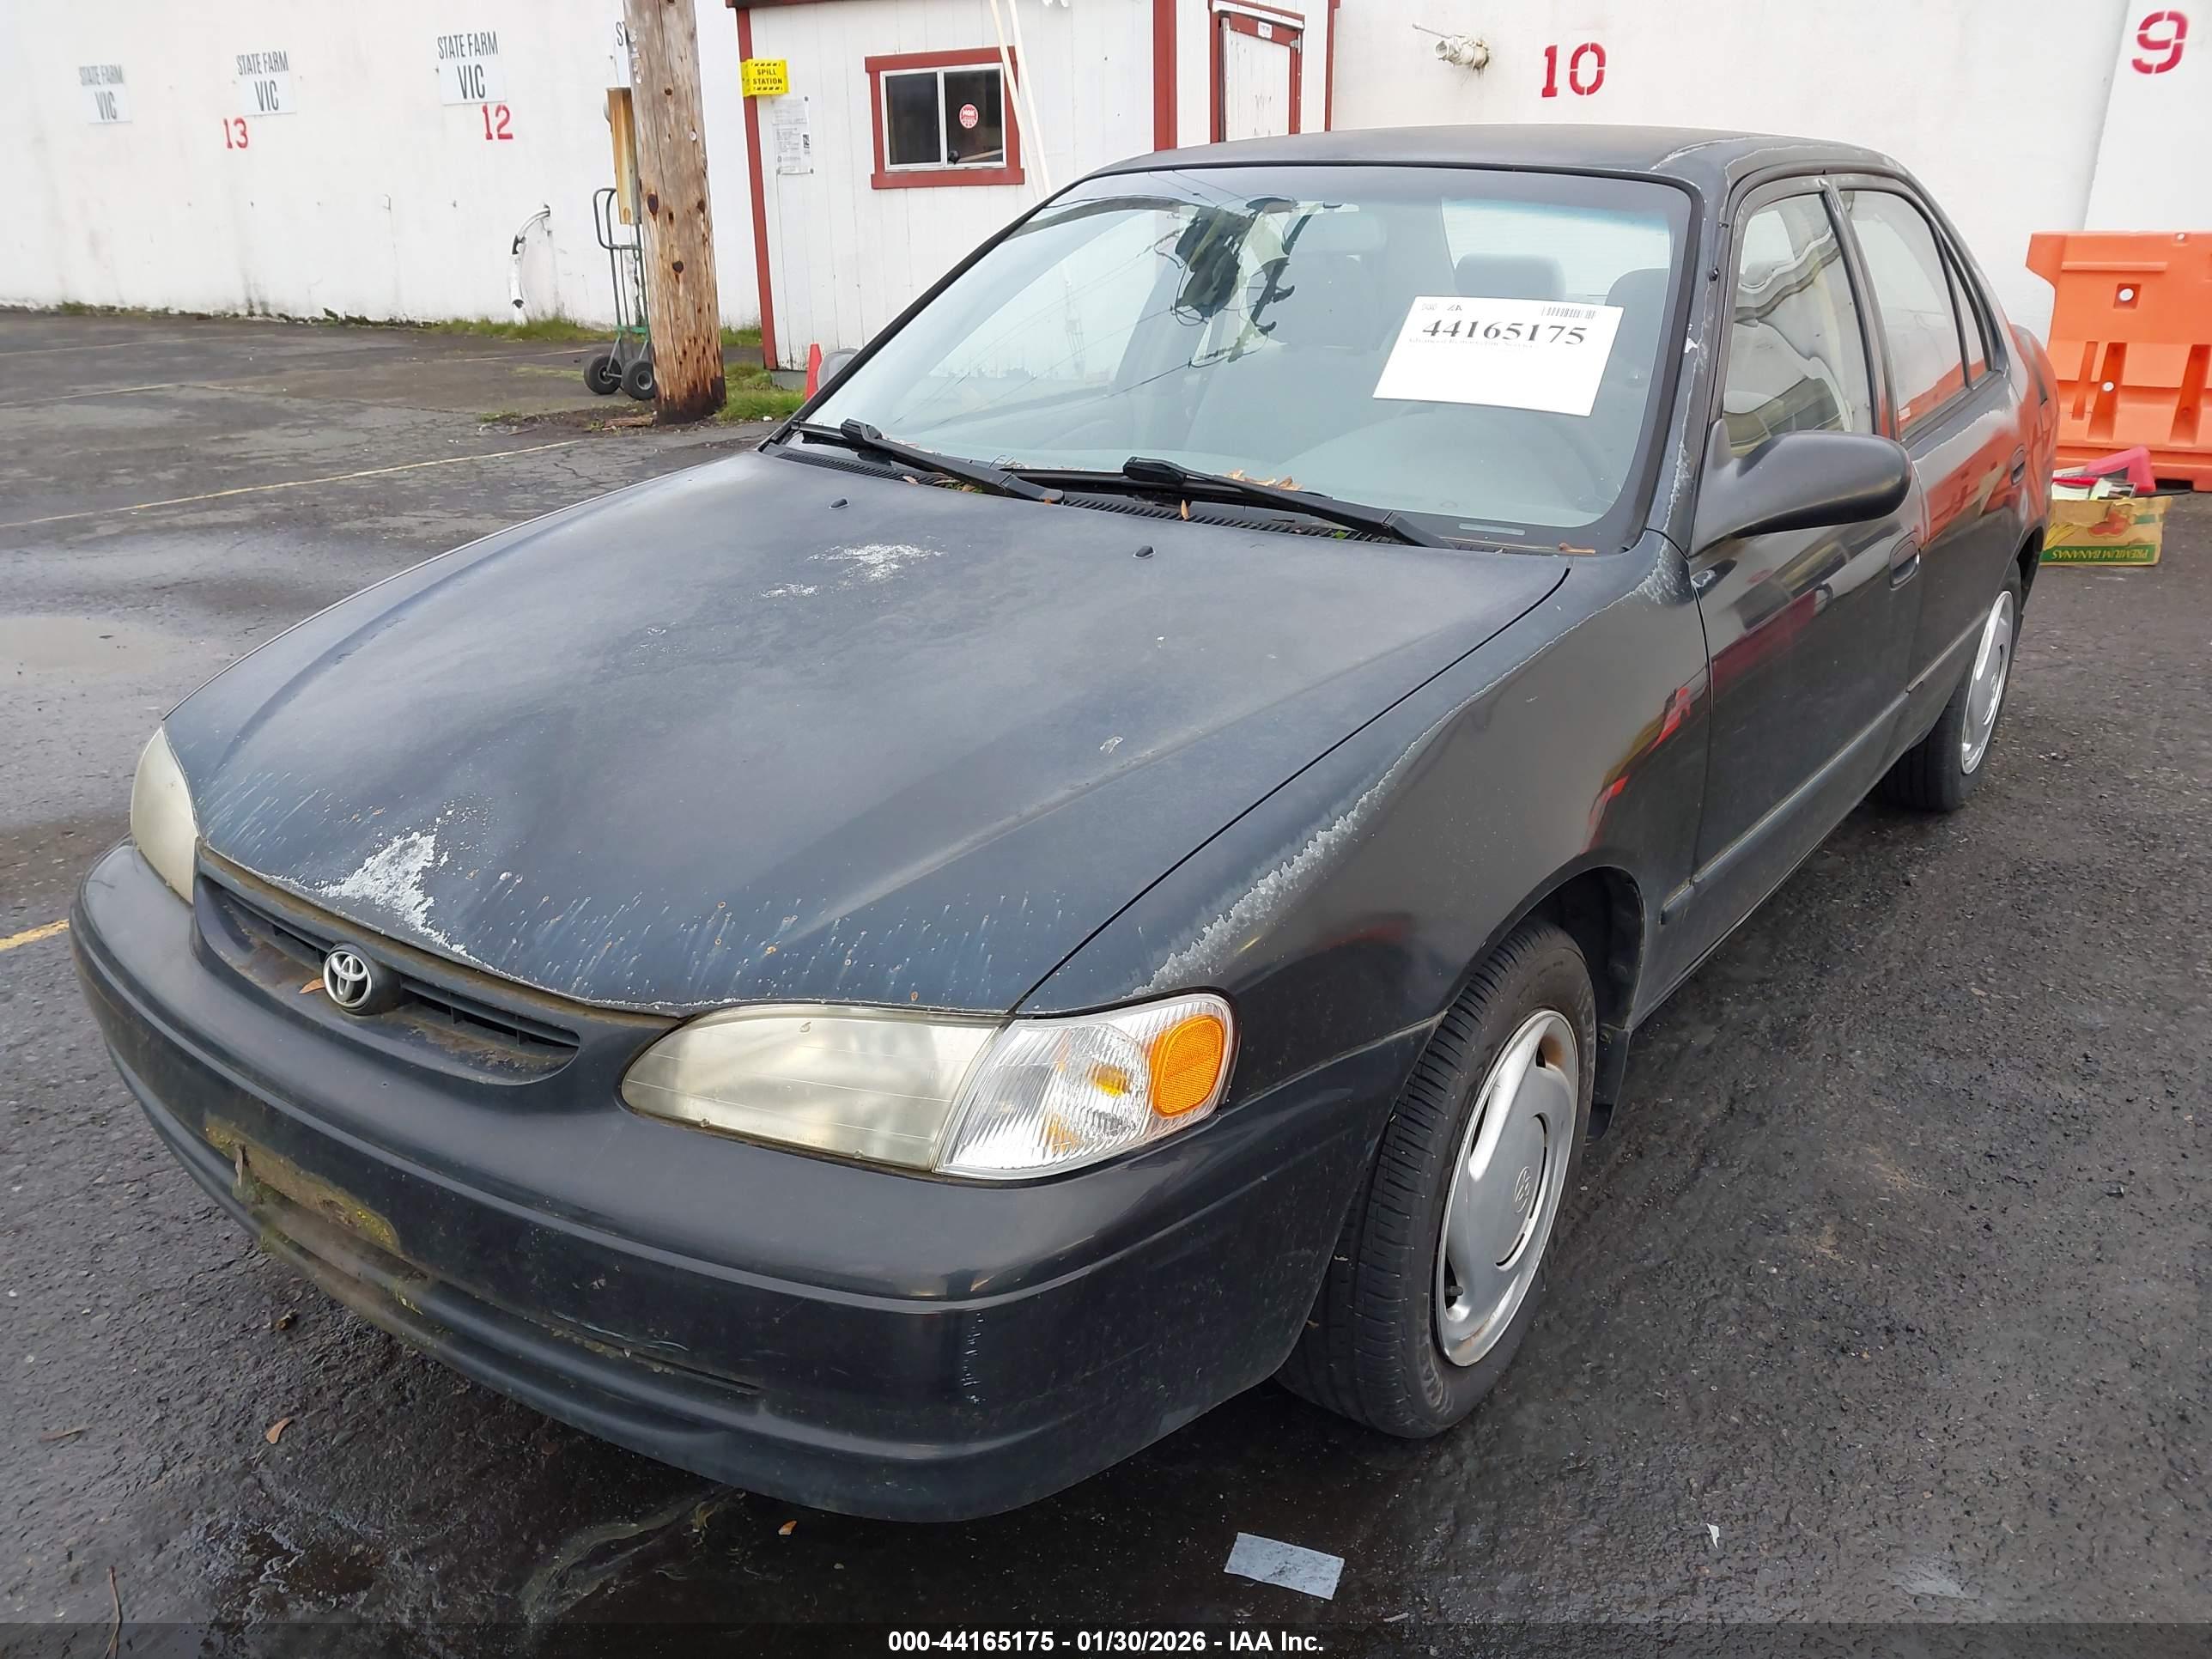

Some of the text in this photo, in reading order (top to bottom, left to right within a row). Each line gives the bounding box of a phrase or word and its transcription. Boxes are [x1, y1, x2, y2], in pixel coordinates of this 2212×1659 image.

[437, 31, 499, 59] STATE FARM
[2131, 10, 2189, 75] 9
[236, 51, 289, 76] STATE FARM
[1541, 42, 1606, 98] 10
[254, 80, 279, 112] VIC
[457, 64, 486, 100] VIC
[94, 91, 117, 120] VIC
[223, 118, 248, 149] 13
[482, 105, 514, 140] 12
[1422, 319, 1588, 344] 44165175
[2052, 549, 2100, 559] BANANAS
